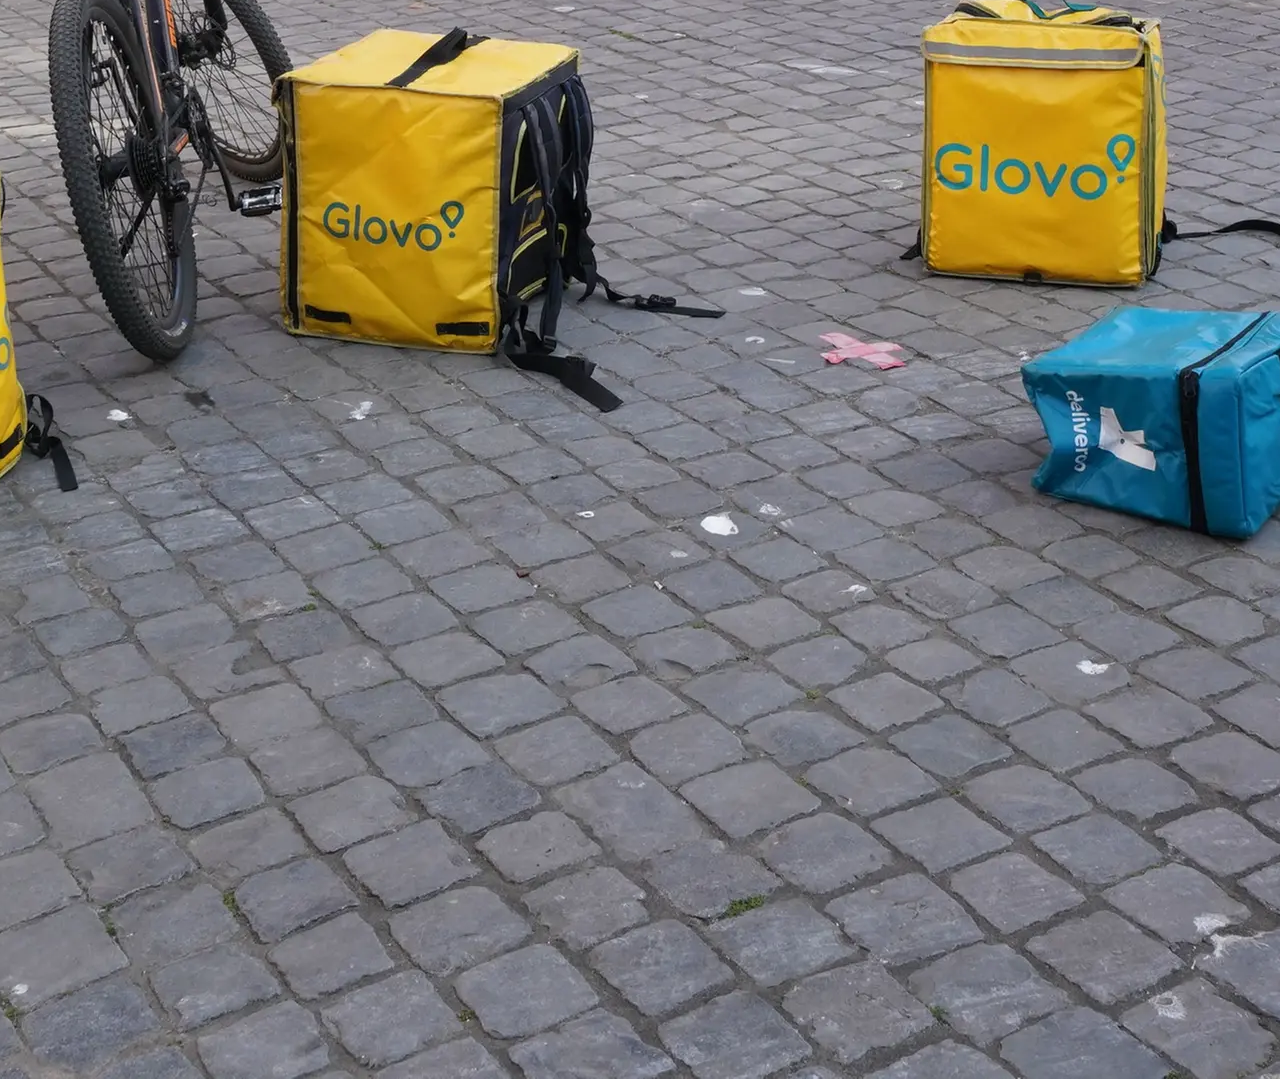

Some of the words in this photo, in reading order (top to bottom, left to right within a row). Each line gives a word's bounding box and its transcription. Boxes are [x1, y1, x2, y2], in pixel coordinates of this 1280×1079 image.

[934, 142, 1109, 201] Glovo
[323, 201, 443, 252] Glovo
[1066, 390, 1091, 473] deliveroo
